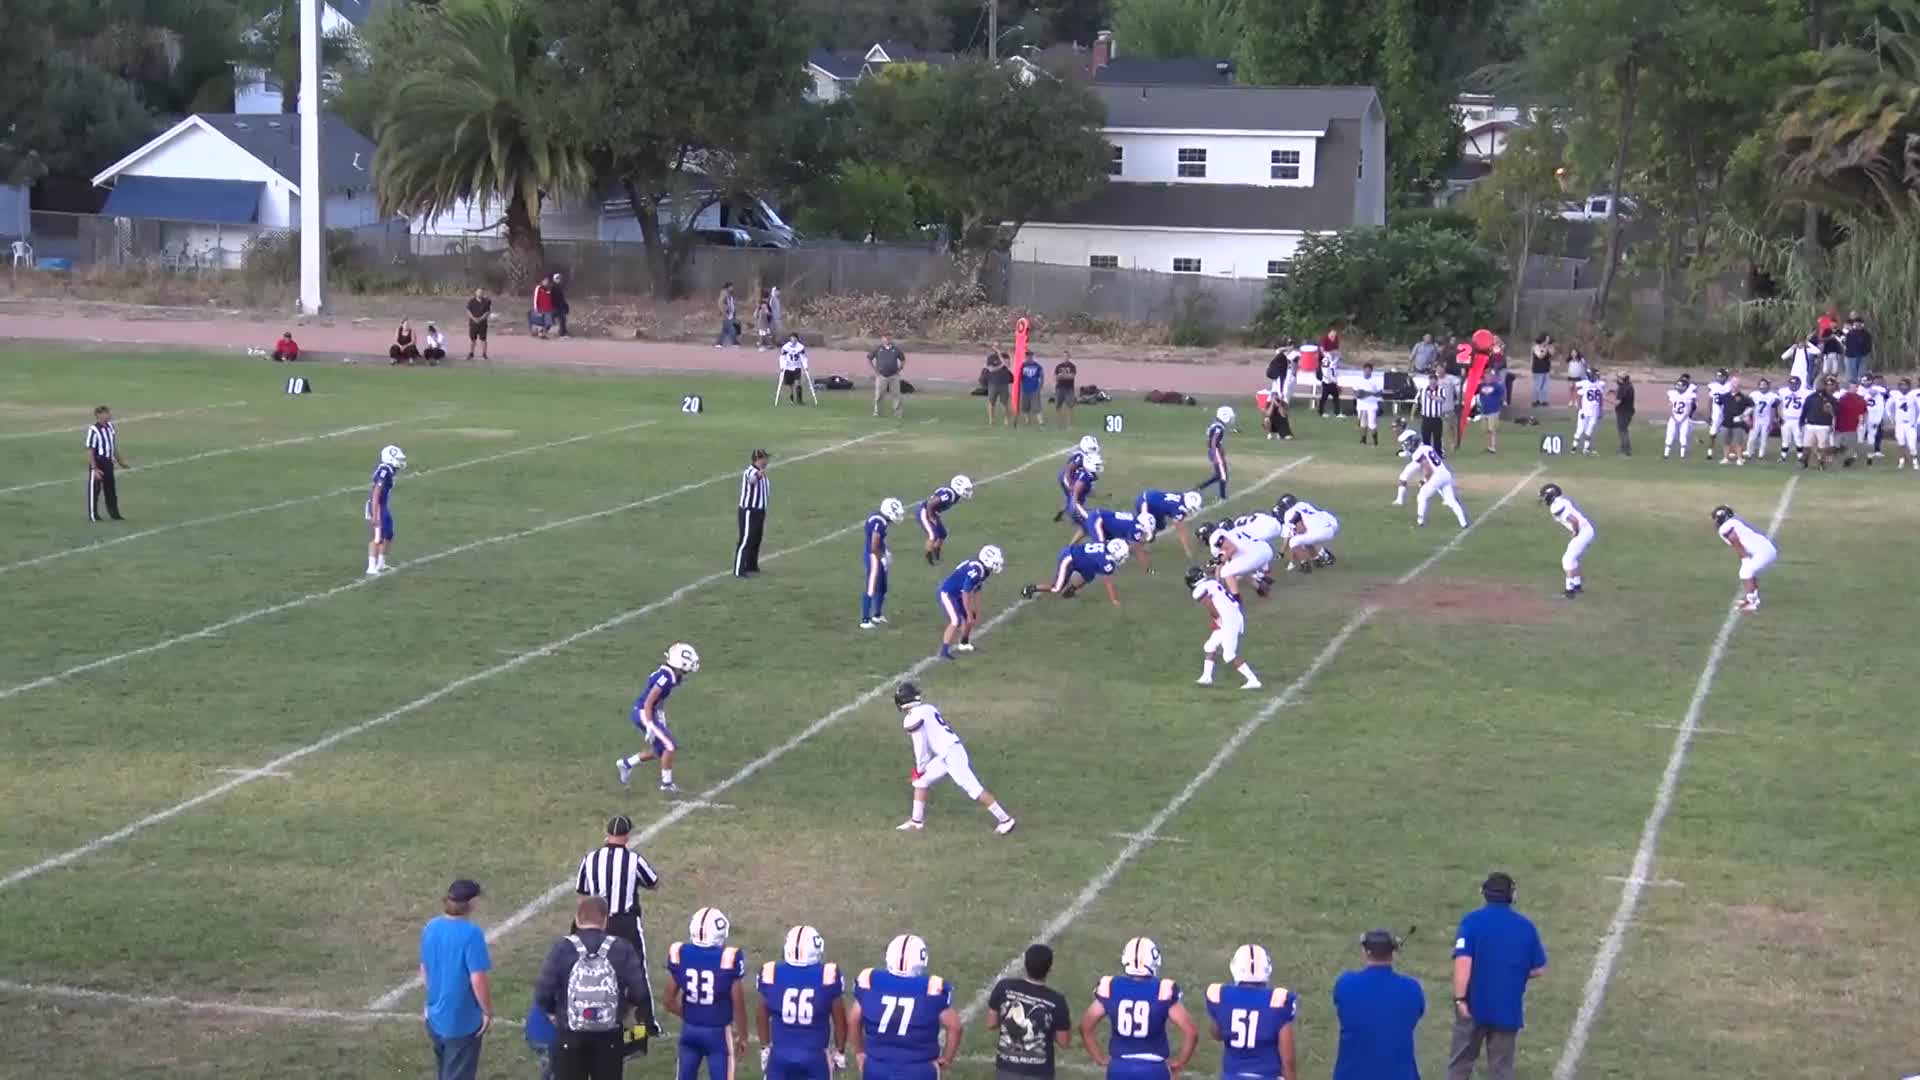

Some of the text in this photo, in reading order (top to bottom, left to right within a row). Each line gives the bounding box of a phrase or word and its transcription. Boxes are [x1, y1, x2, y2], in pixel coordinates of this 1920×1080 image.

[288, 378, 303, 394] 10
[682, 397, 699, 412] 20
[1784, 396, 1801, 410] 75
[1106, 415, 1122, 432] 30
[1542, 436, 1561, 454] 40
[685, 968, 715, 1005] 33
[782, 988, 815, 1025] 66
[877, 995, 915, 1036] 77
[1117, 1000, 1150, 1038] 69
[1230, 1008, 1259, 1048] 51
